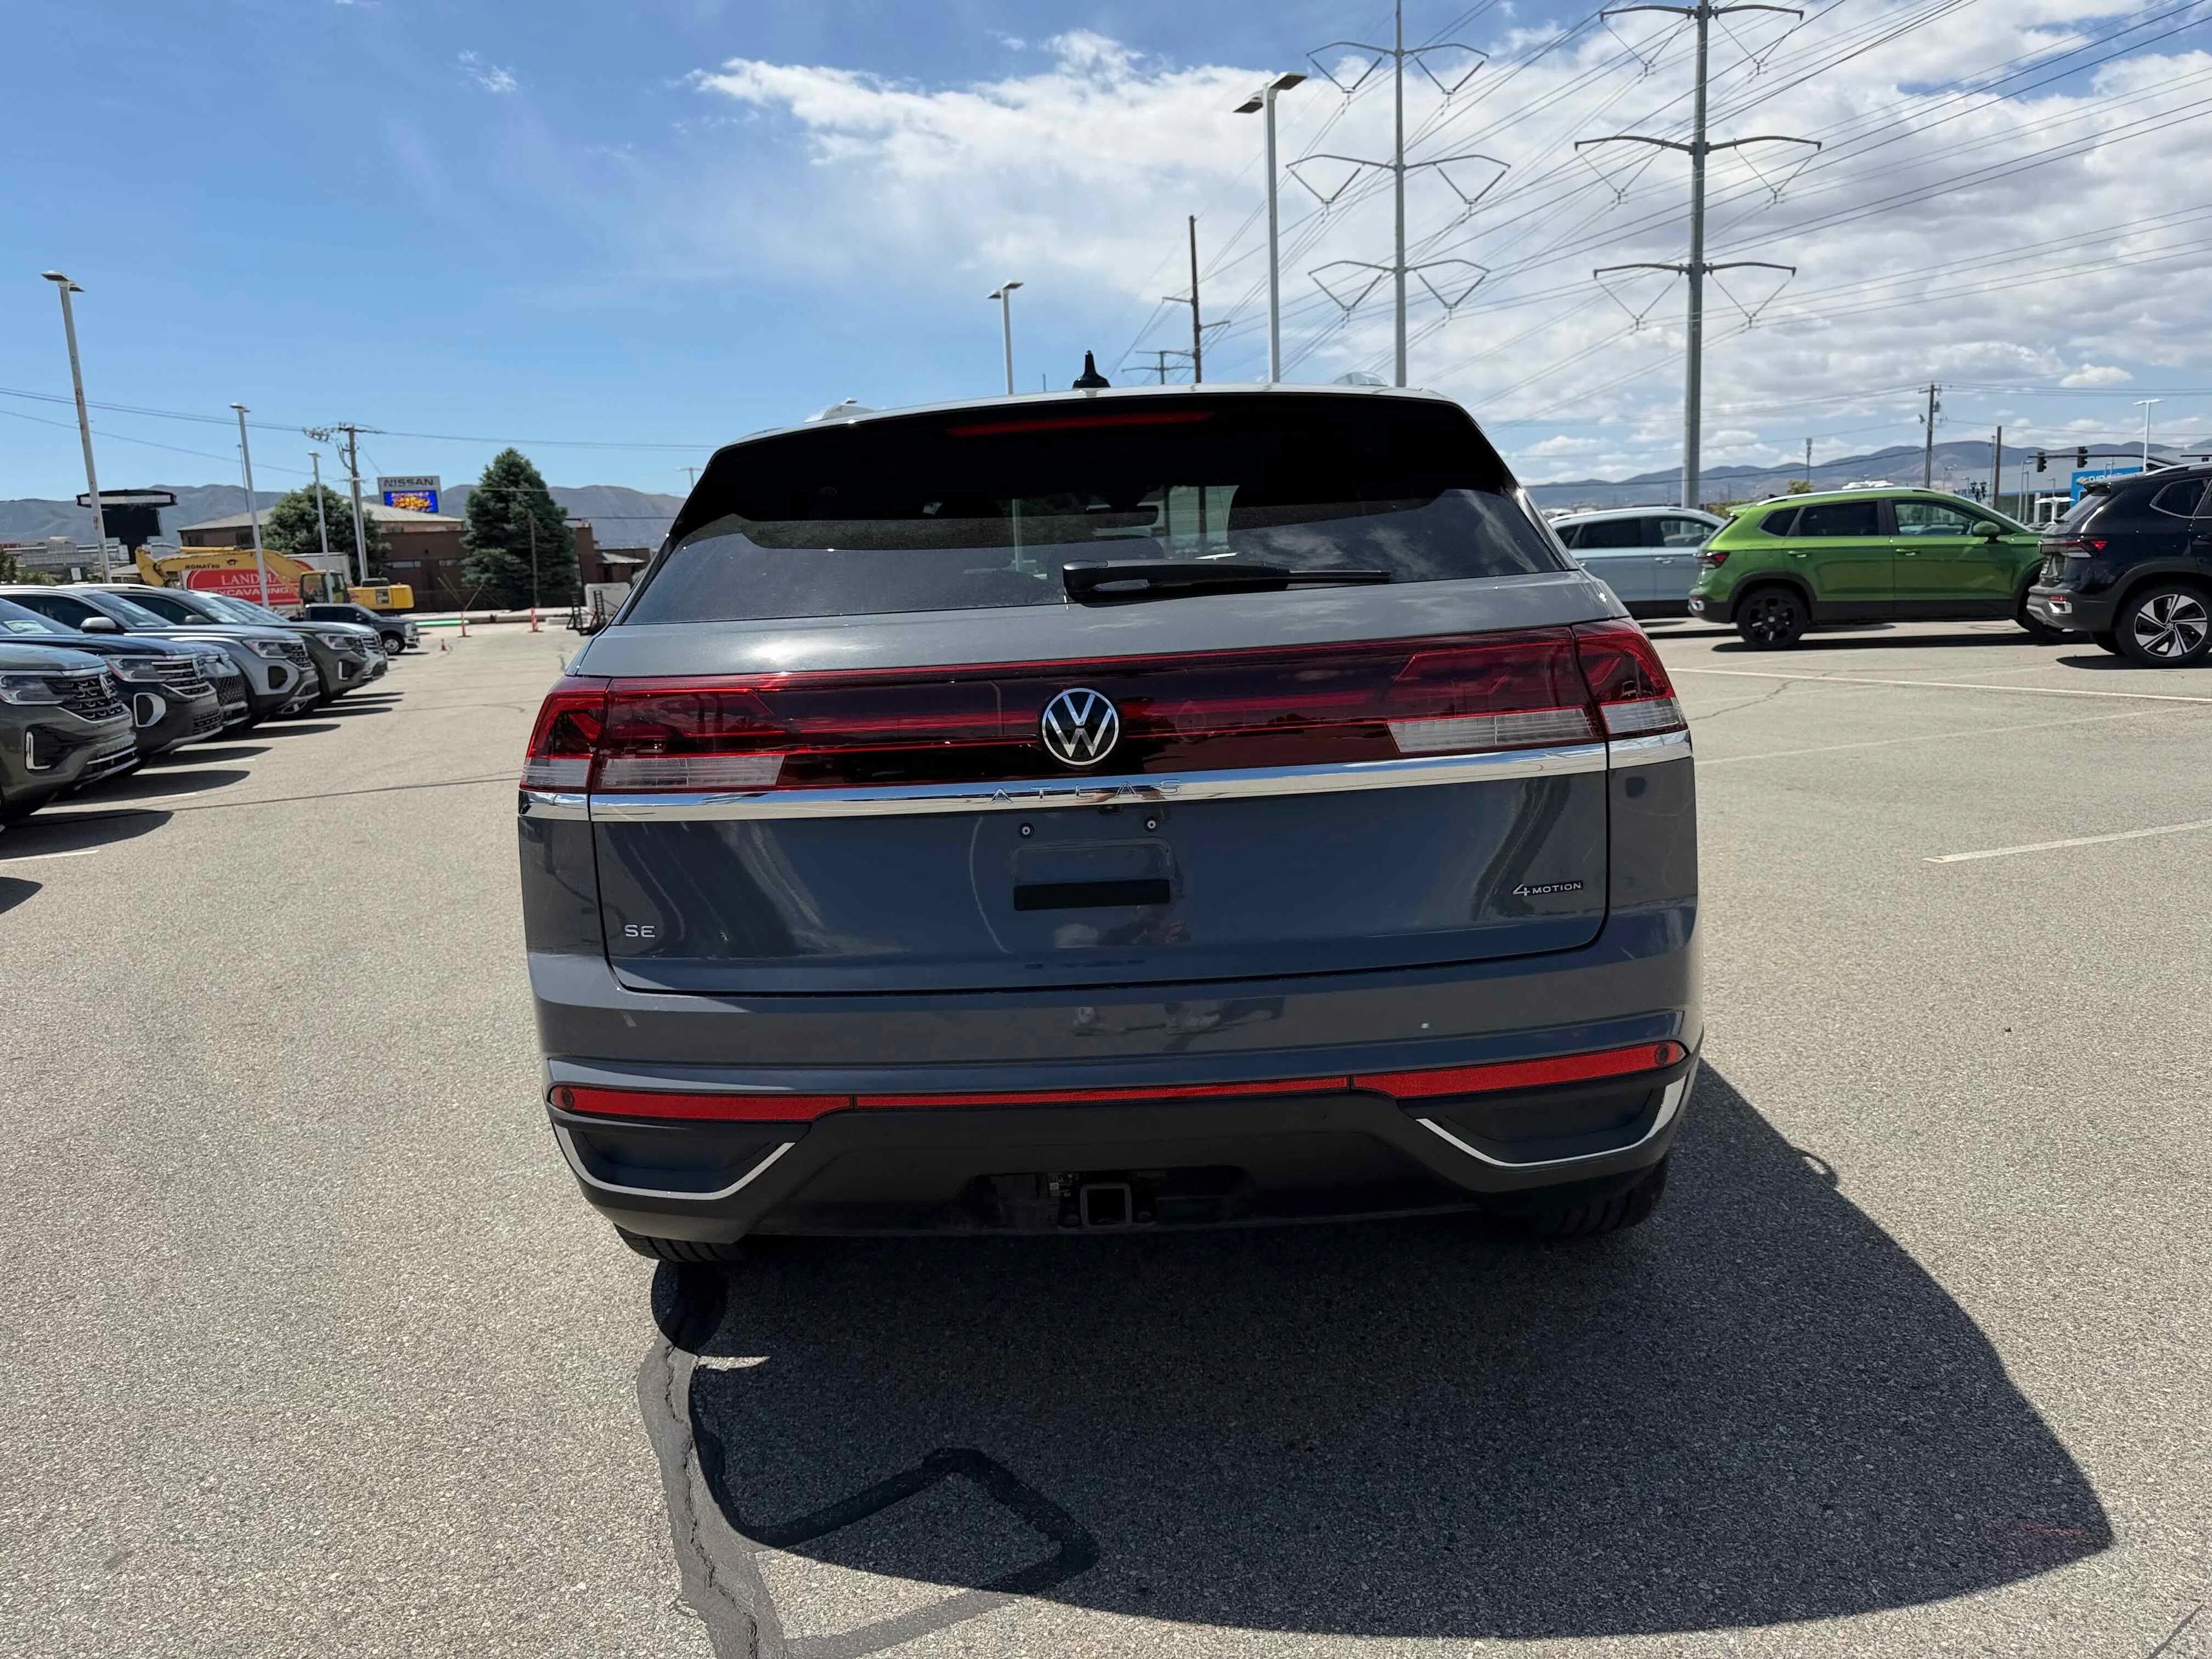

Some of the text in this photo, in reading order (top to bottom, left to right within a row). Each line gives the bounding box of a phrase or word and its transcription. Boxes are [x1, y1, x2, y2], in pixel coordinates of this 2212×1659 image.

[384, 478, 434, 487] NISSAN
[991, 779, 1181, 804] ATLAS
[625, 924, 656, 938] SE
